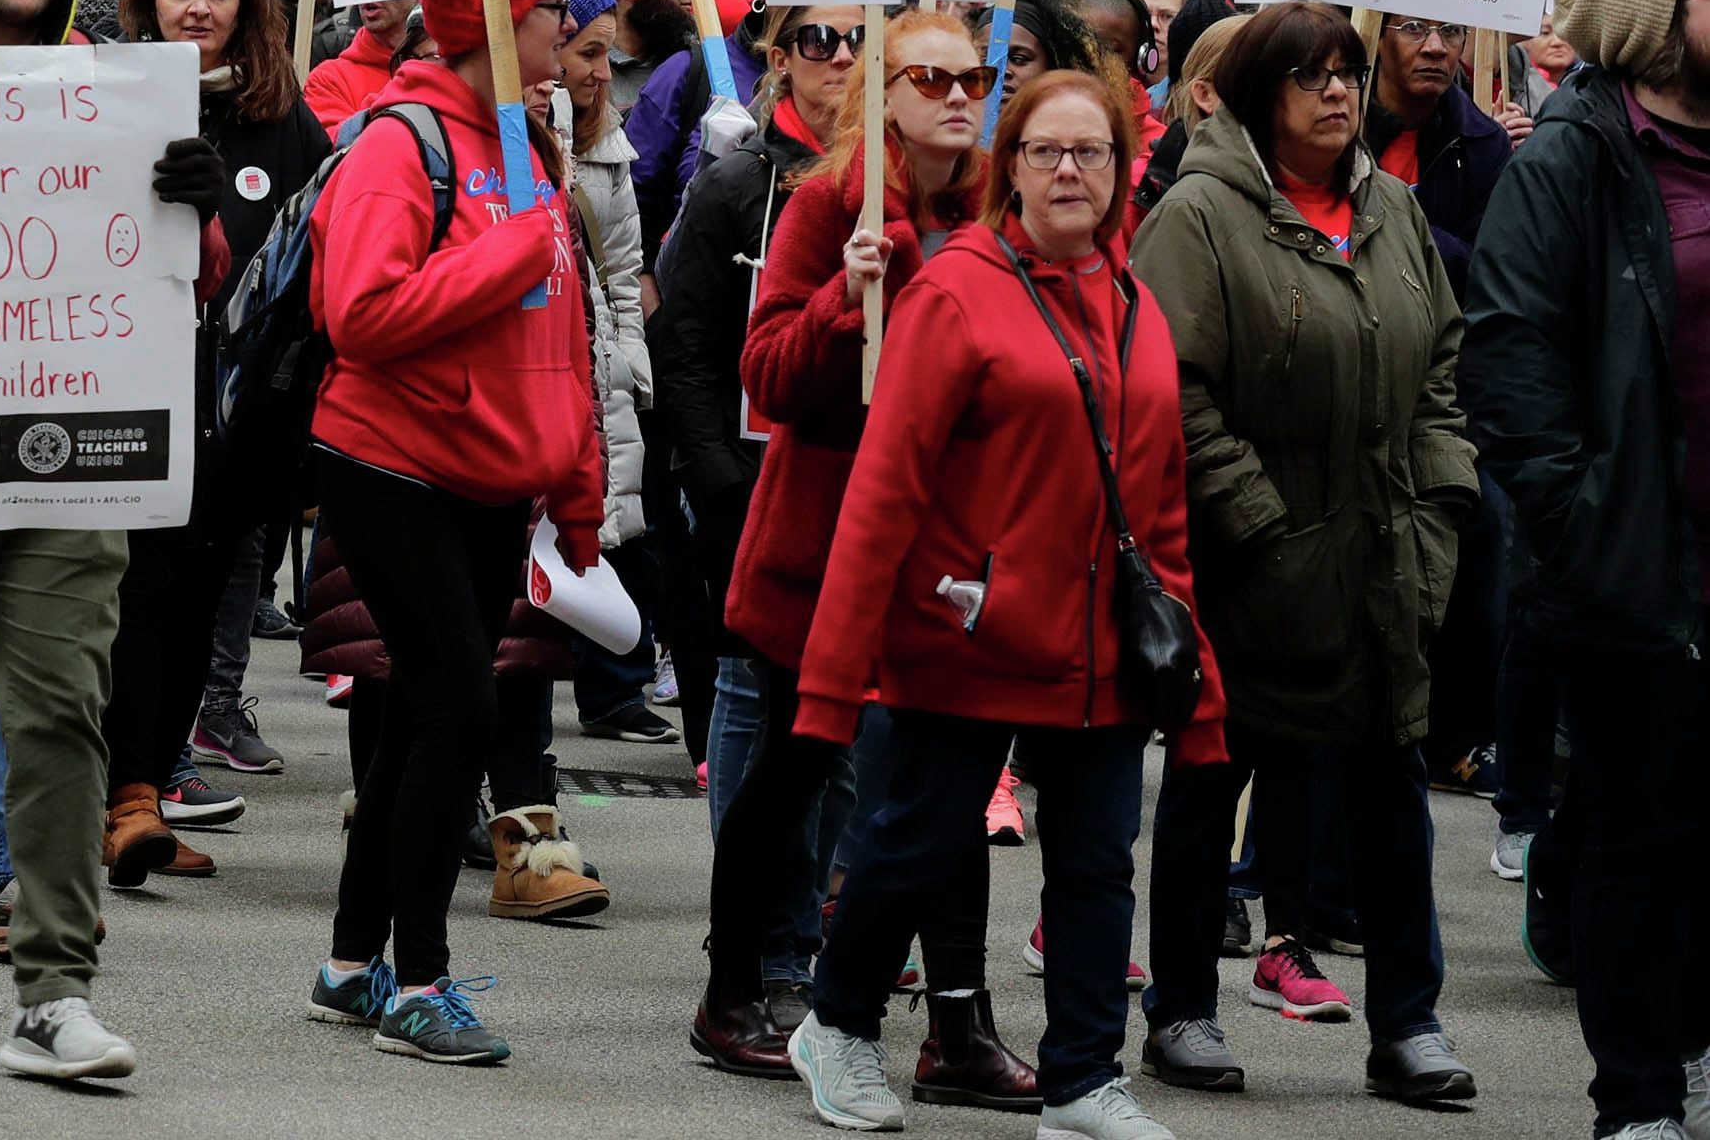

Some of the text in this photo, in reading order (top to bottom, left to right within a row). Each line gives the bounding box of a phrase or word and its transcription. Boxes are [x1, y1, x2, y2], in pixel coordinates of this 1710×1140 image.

[59, 77, 99, 121] is
[38, 165, 101, 195] our
[76, 428, 145, 441] CHICAGO
[77, 441, 148, 453] TEACHERS
[76, 454, 124, 466] UNION
[62, 496, 88, 504] Local
[103, 495, 141, 504] AFL-CIO
